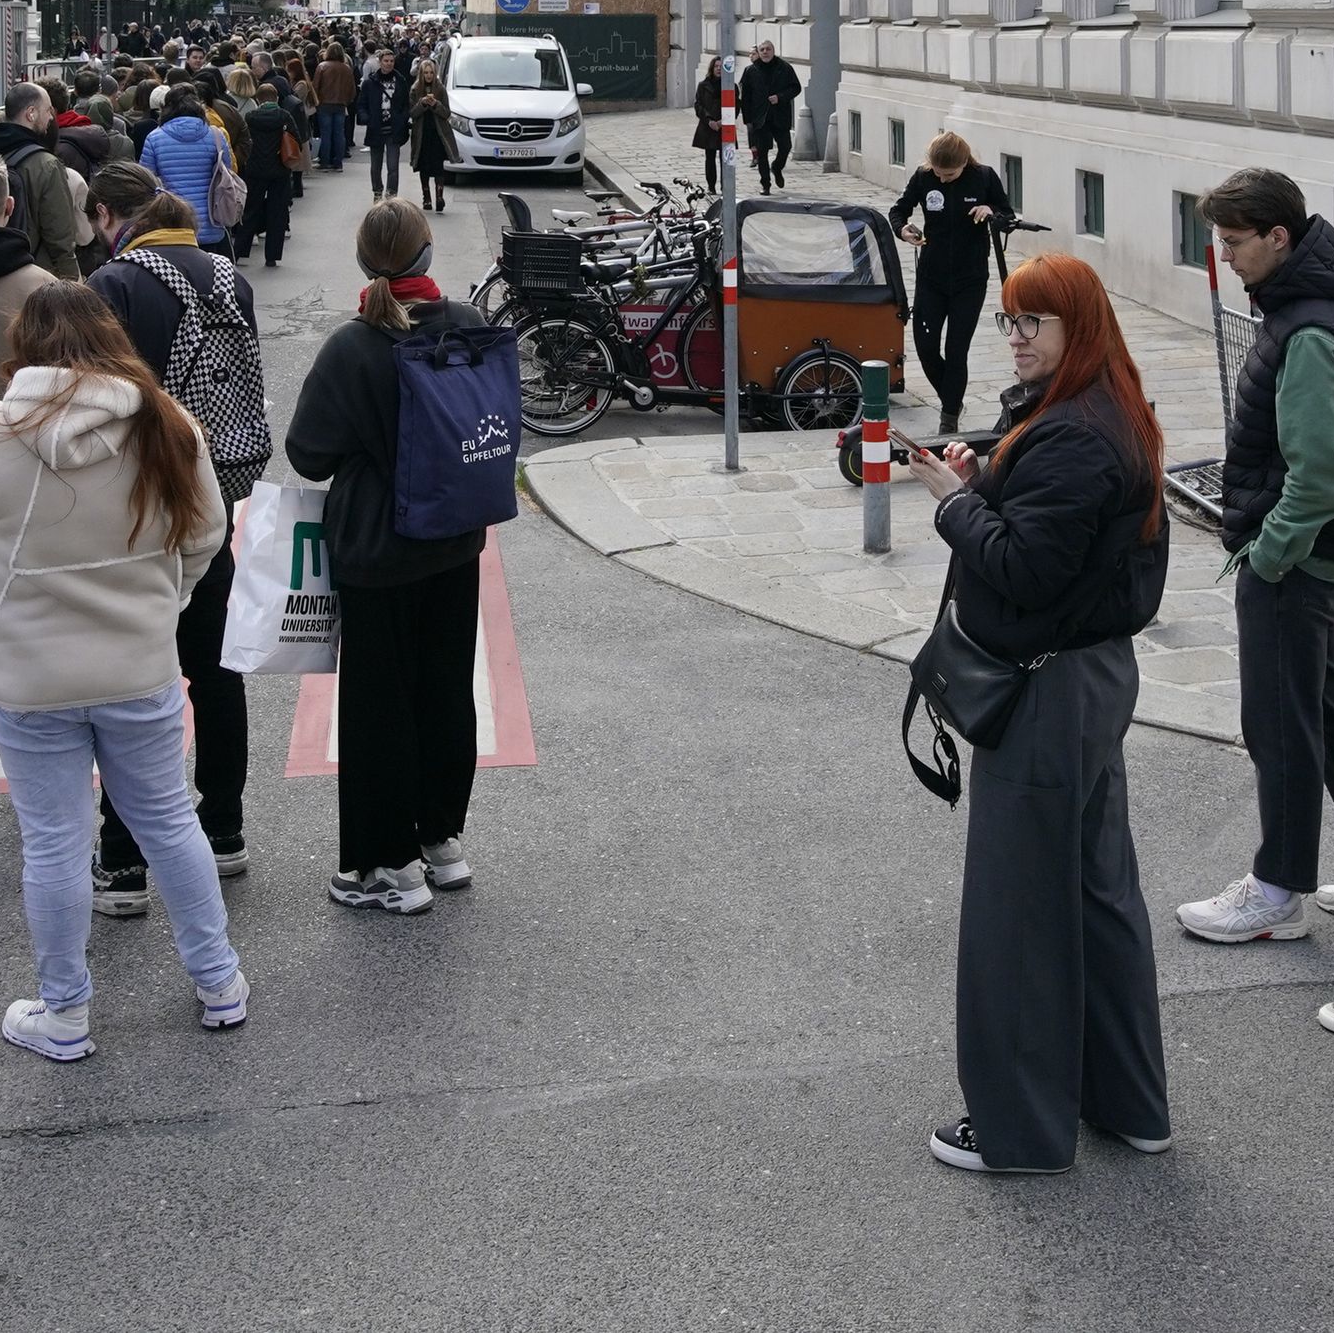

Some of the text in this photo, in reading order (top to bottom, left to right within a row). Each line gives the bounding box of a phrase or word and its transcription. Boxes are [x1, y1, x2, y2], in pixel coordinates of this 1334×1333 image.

[501, 26, 554, 34] Unsere Herzen
[462, 439, 476, 452] EU
[462, 444, 512, 463] GIPFELTOUR
